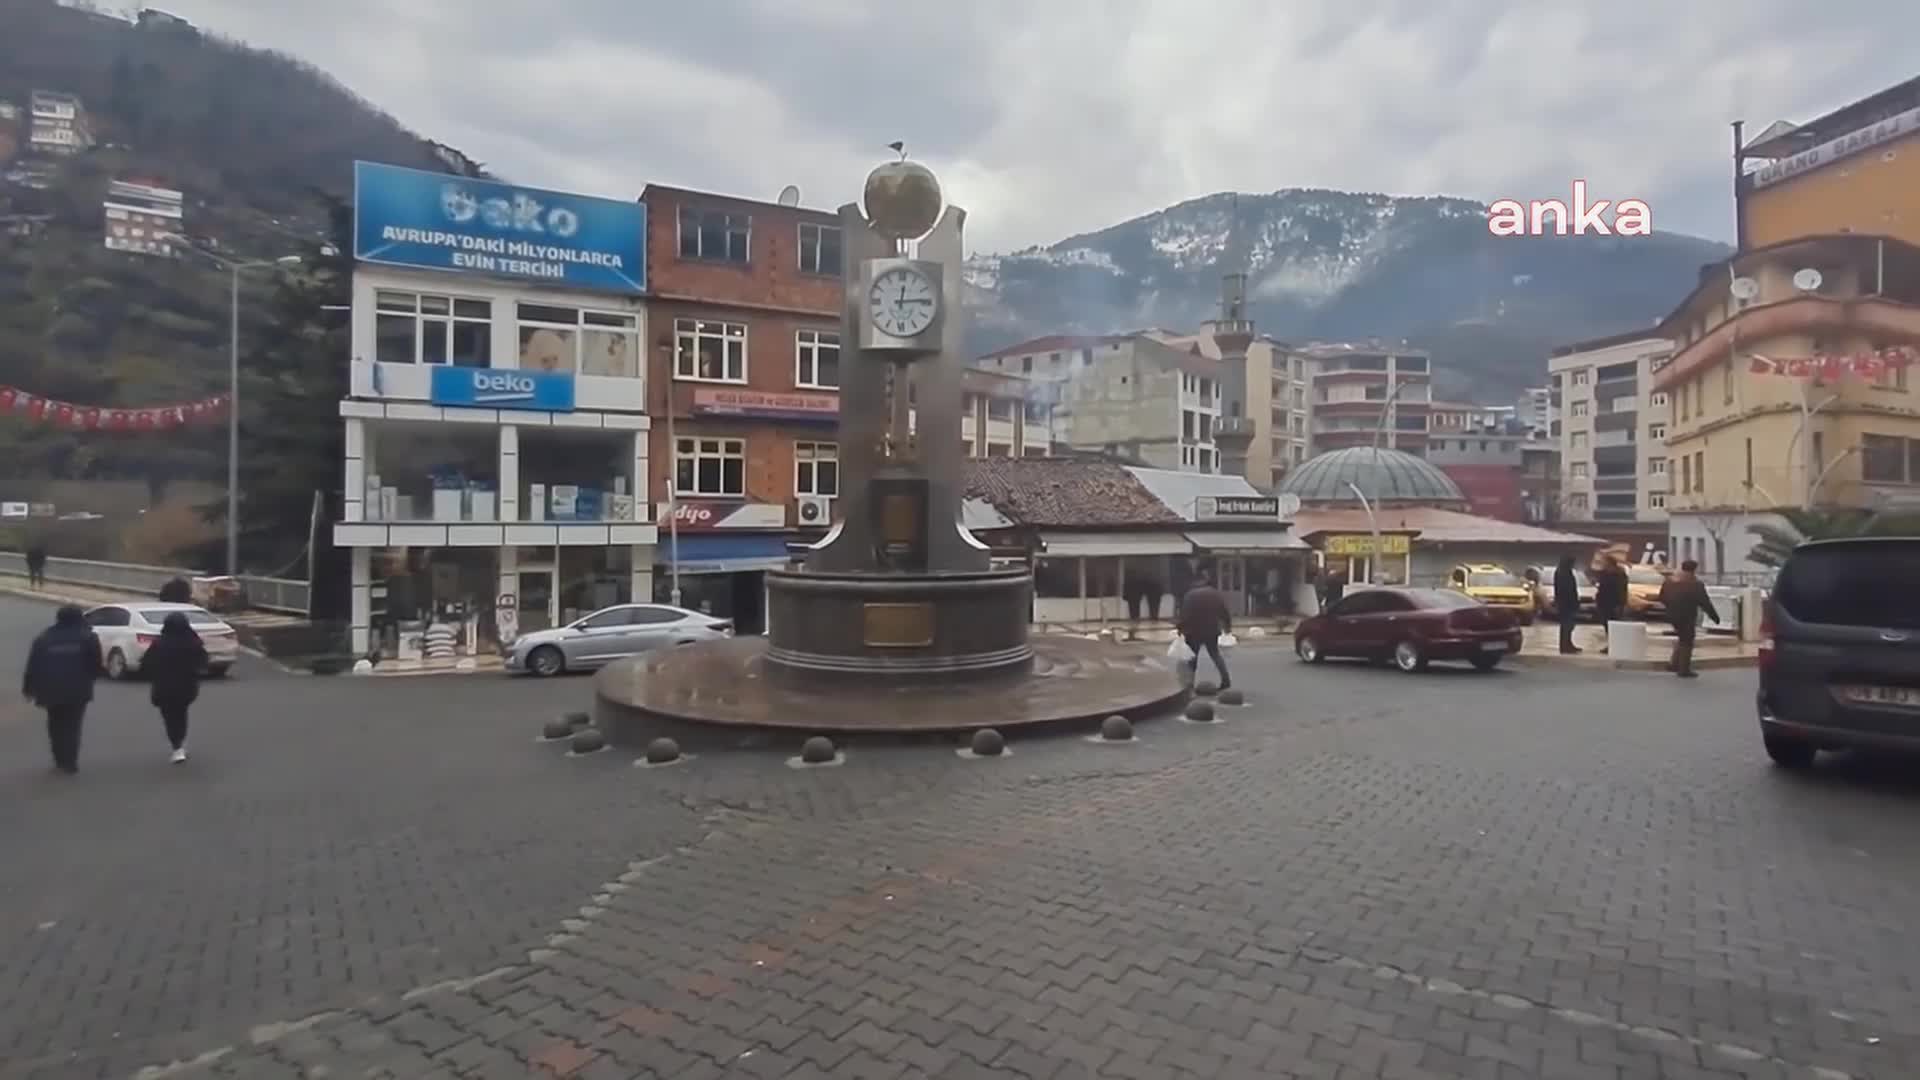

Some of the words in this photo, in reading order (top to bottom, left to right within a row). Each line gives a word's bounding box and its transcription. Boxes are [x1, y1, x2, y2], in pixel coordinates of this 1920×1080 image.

[382, 225, 505, 254] AVRUPA'DAKİ
[507, 239, 624, 268] MİLYONLARCA
[452, 252, 496, 271] EVİN
[500, 257, 565, 278] TERCİHİ
[473, 371, 535, 392] beko
